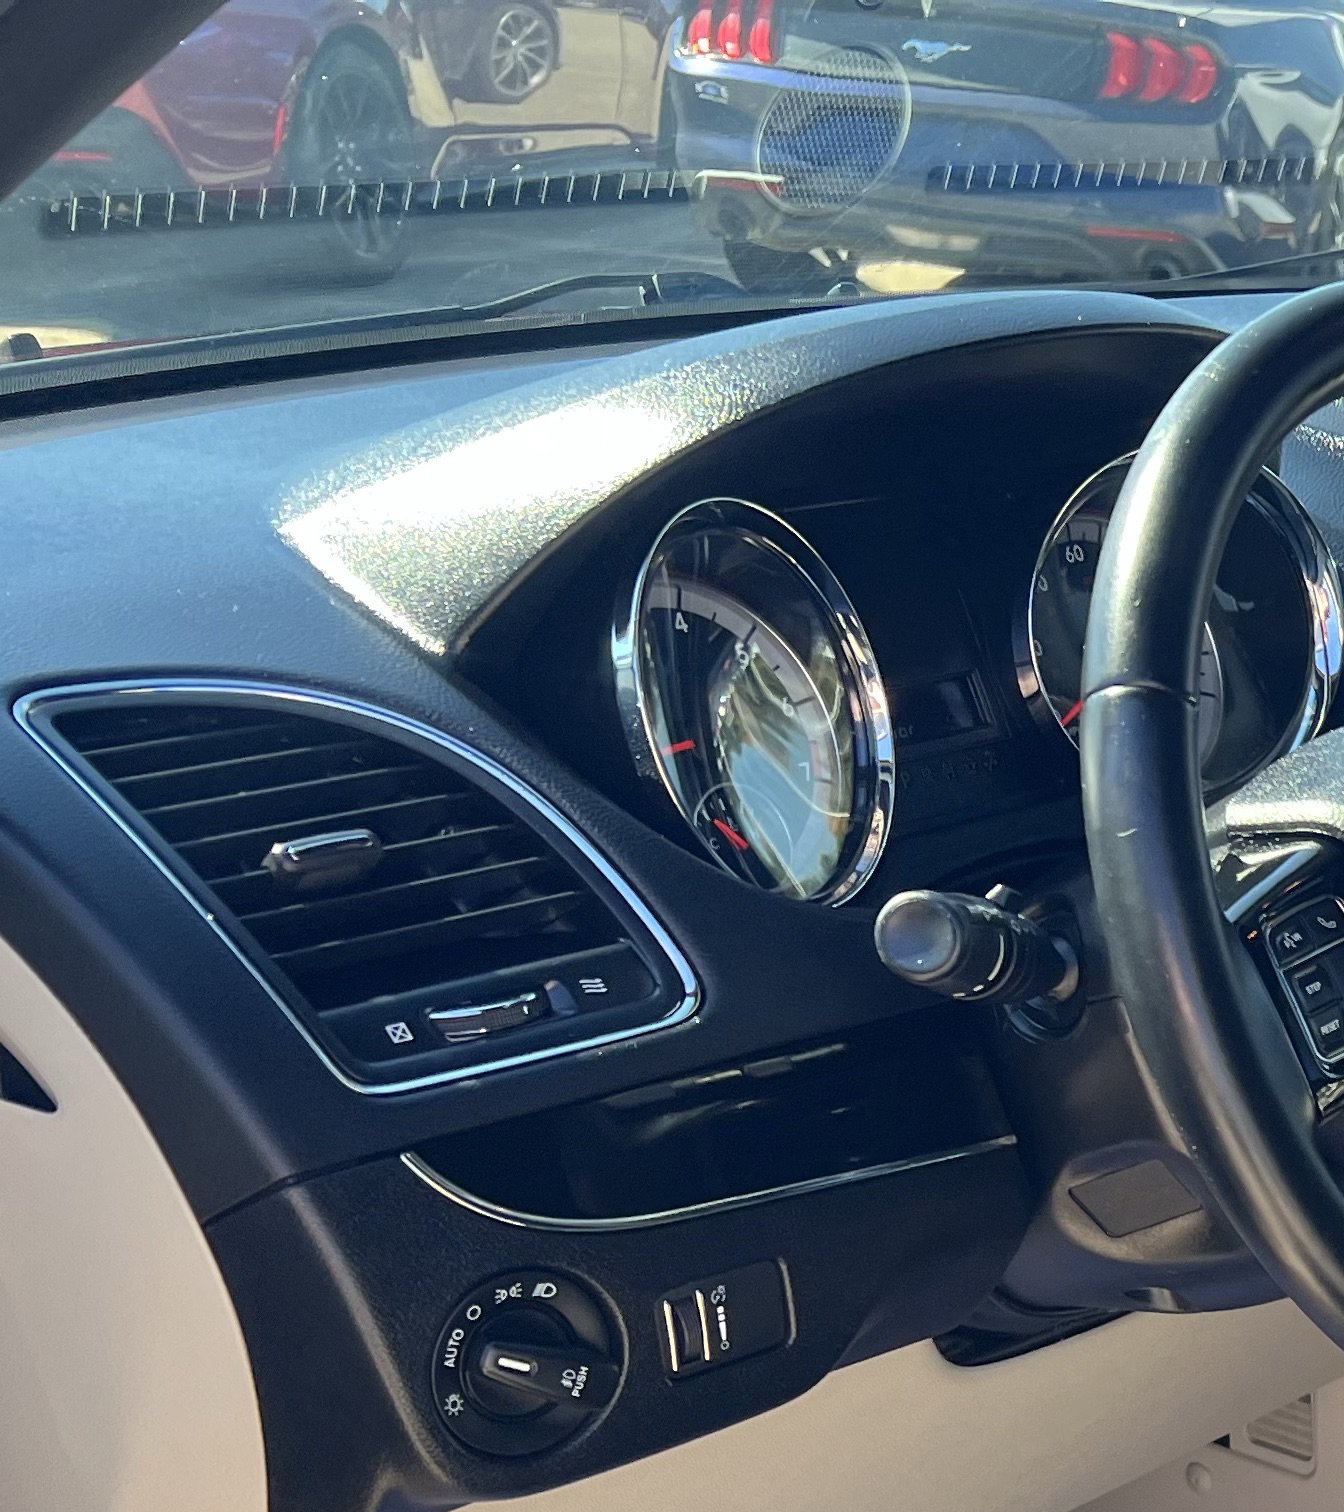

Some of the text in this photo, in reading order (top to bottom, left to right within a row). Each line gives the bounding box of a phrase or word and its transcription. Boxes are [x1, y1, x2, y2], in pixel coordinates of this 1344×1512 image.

[1065, 544, 1085, 564] 60
[674, 611, 689, 634] 4
[798, 761, 811, 782] 7
[444, 1328, 465, 1368] AUTO
[571, 1365, 589, 1398] PUSH
